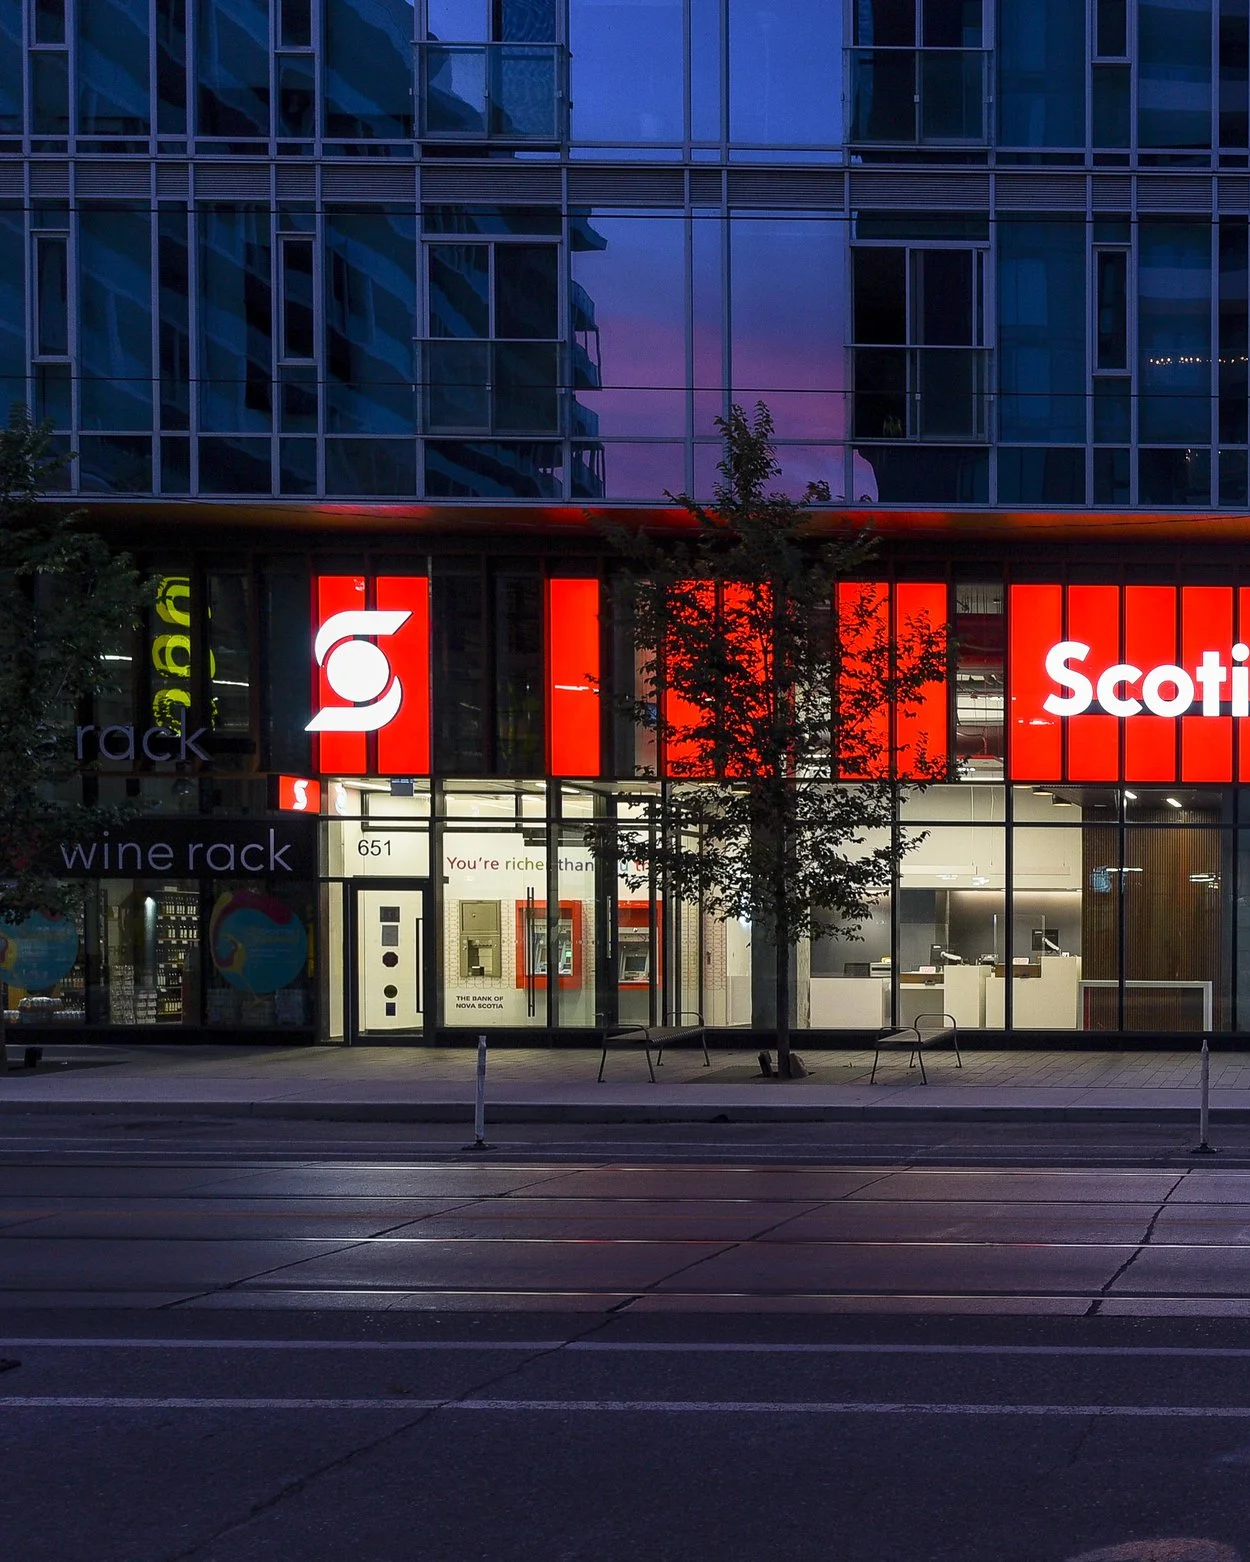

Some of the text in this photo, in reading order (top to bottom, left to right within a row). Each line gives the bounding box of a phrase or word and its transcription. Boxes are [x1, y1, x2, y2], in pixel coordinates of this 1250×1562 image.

[76, 708, 211, 762] rack
[60, 828, 294, 873] wine rack
[357, 839, 392, 857] 651
[446, 855, 594, 872] You're riche than
